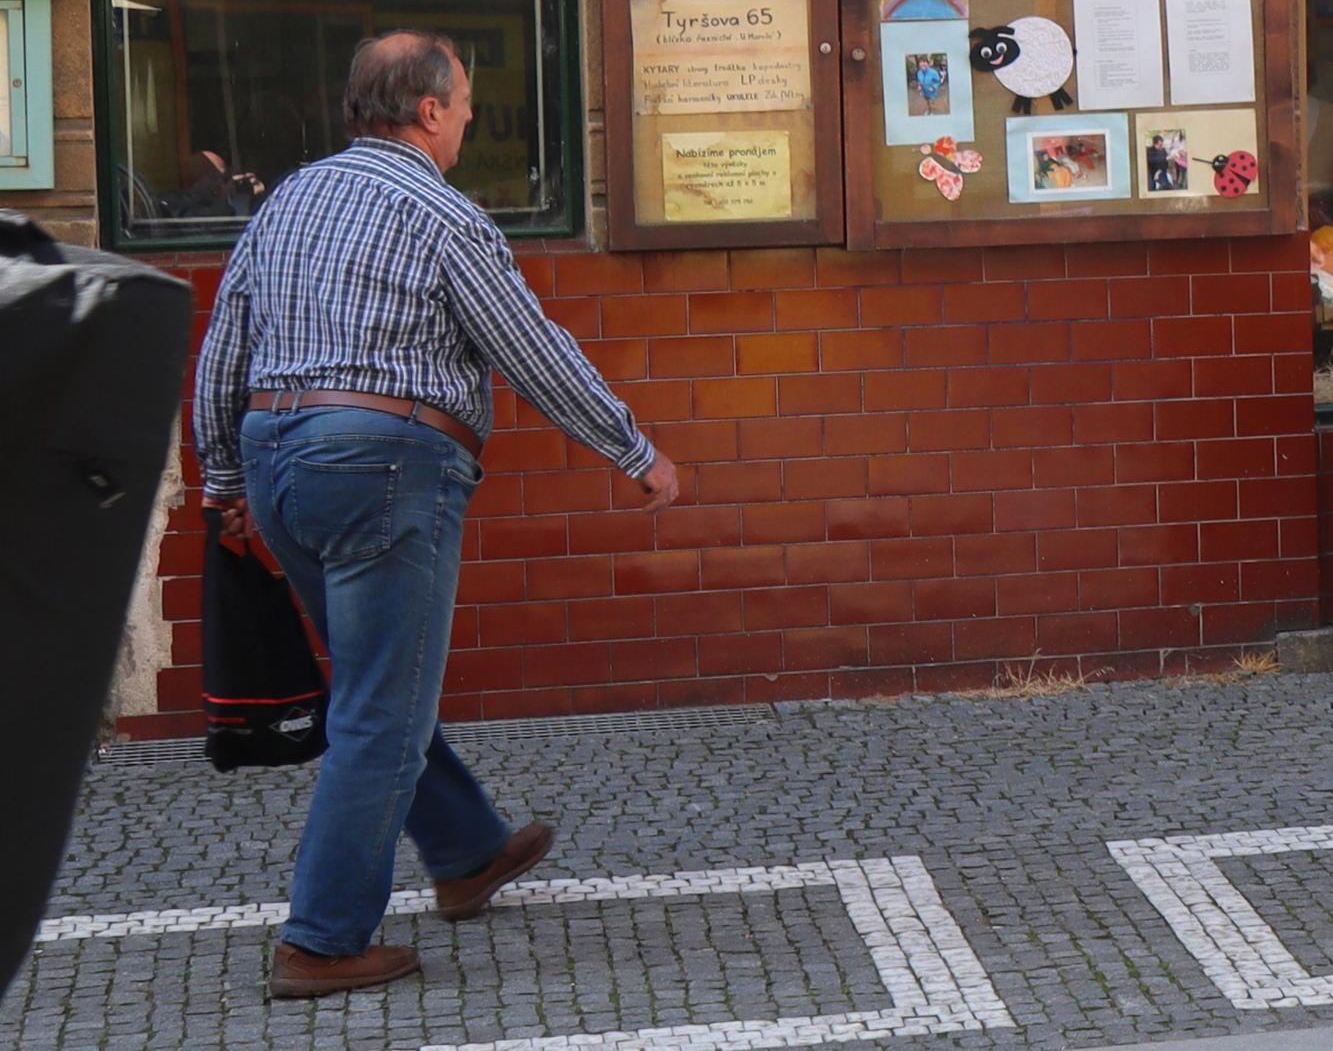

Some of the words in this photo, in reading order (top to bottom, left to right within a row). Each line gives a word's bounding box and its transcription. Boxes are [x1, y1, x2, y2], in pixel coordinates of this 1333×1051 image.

[661, 11, 739, 35] Tyršova
[746, 8, 773, 25] 65
[643, 64, 680, 75] KYTARY
[741, 75, 757, 86] LP
[728, 146, 776, 159] pronájem
